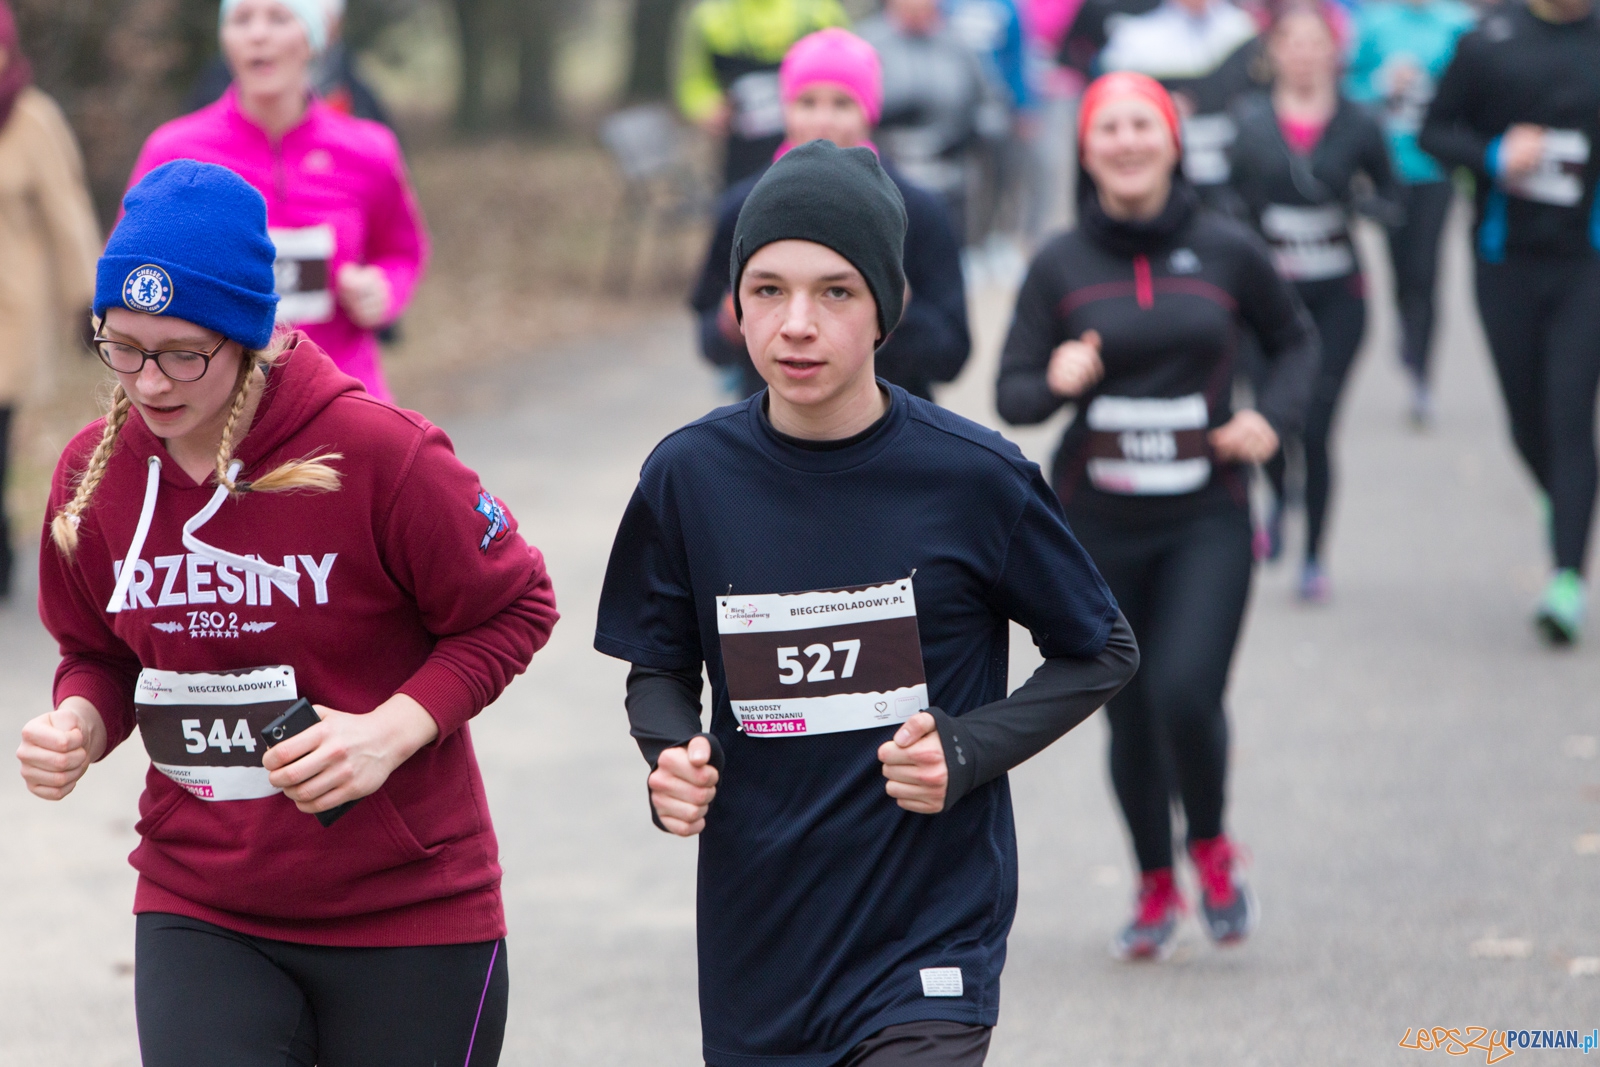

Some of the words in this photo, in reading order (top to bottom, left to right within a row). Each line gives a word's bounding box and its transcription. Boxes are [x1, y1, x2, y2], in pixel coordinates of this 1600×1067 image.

[136, 269, 164, 281] CHELSEA
[790, 595, 906, 617] BIEGCZEKOLADOWY.PL
[186, 610, 225, 629] ZSO
[228, 611, 238, 629] 2
[776, 638, 862, 685] 527
[187, 679, 288, 694] BIEGCZEKOLADOWY.PL
[739, 704, 782, 713] NAJSŁODSZY
[765, 712, 803, 720] POZNANIU
[744, 722, 794, 732] 14.02.2016
[796, 723, 806, 731] r.
[181, 718, 257, 754] 544
